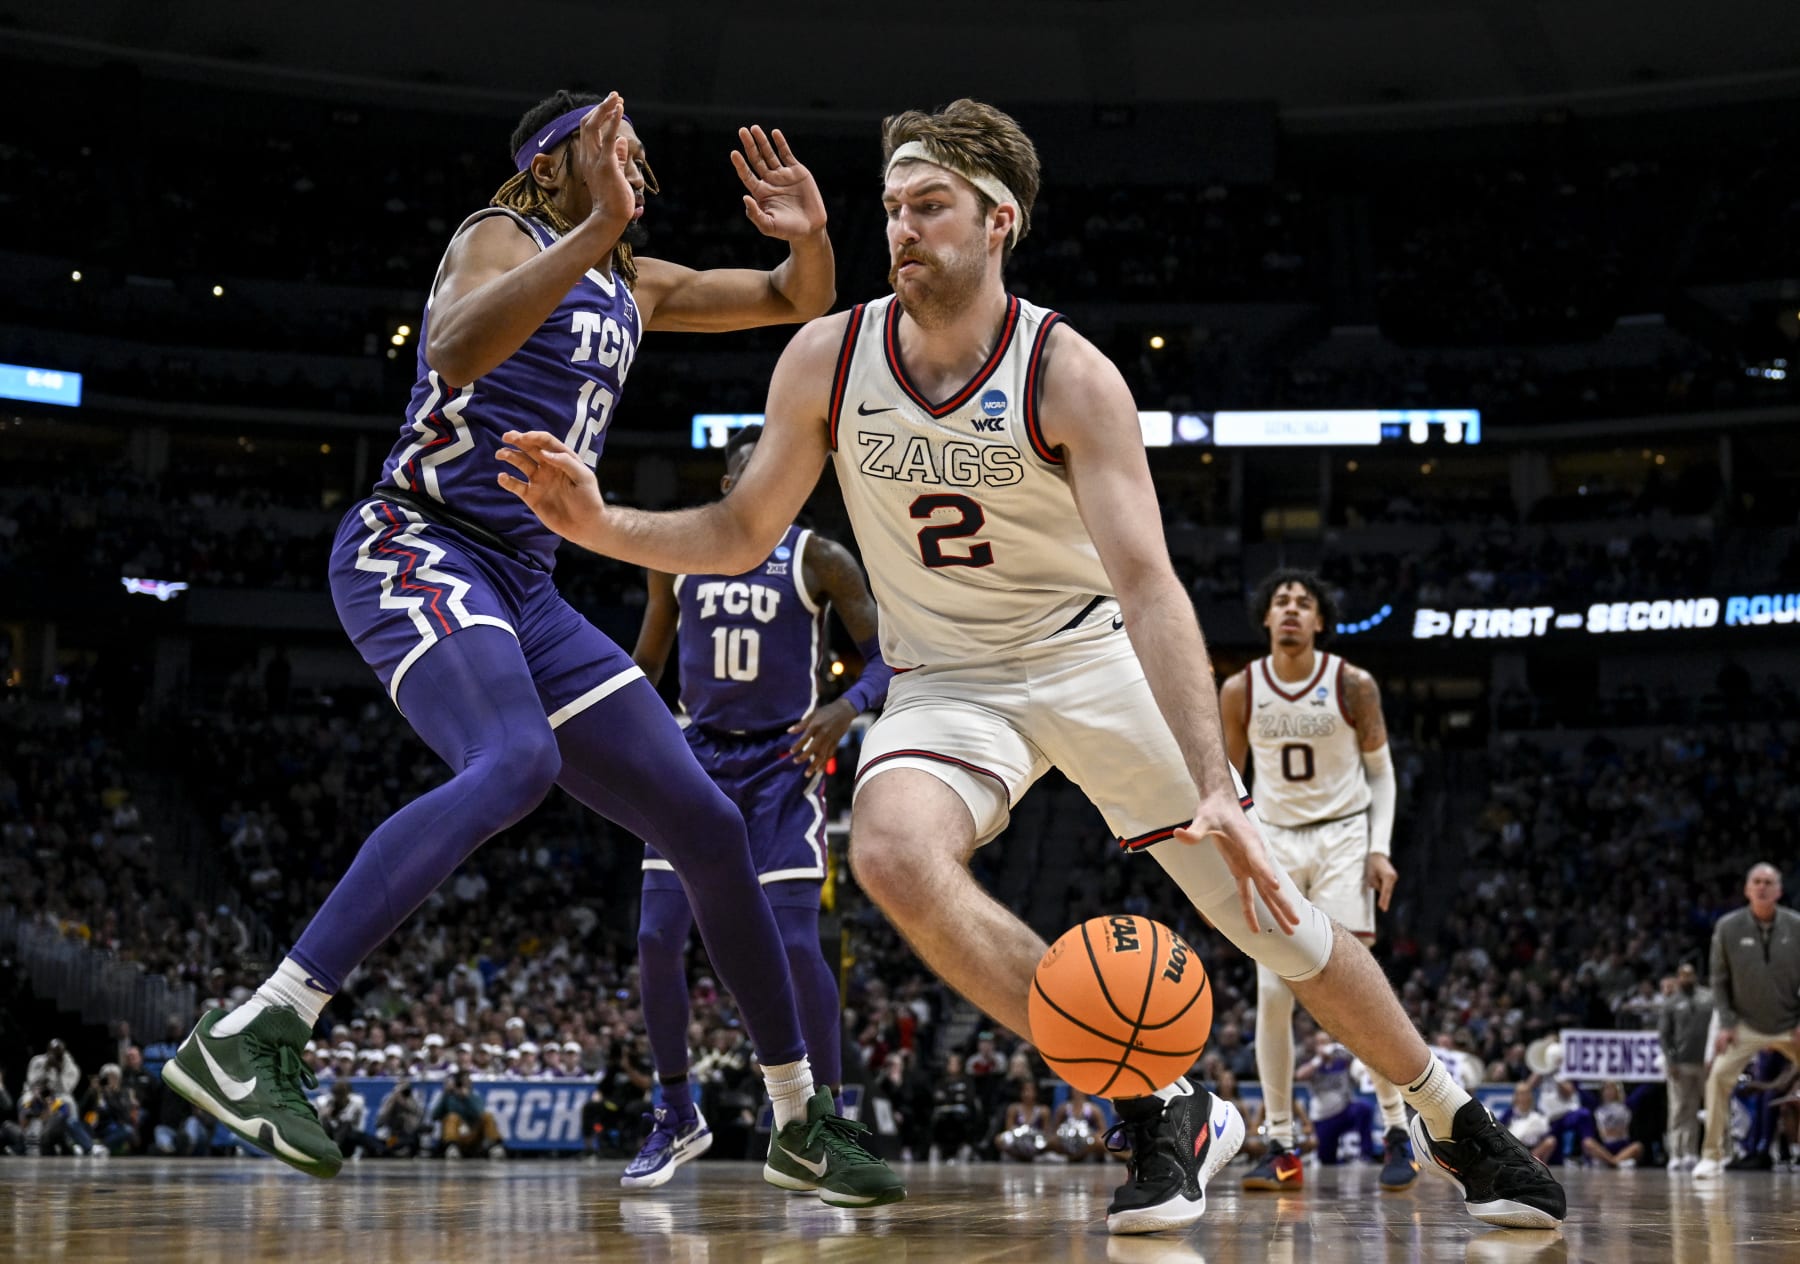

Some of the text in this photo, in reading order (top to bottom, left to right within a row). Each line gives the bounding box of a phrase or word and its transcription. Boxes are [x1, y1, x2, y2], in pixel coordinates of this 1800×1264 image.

[571, 312, 634, 387] TCU
[564, 380, 614, 468] 12
[971, 418, 1005, 432] WCC
[984, 401, 1006, 409] NCAA
[858, 431, 1024, 487] ZAGS
[909, 493, 994, 568] 2
[696, 582, 781, 623] TCU
[1453, 606, 1554, 638] FIRST
[1586, 598, 1719, 633] SECOND
[1725, 593, 1800, 626] ROU
[711, 627, 760, 681] 10
[1258, 713, 1335, 737] ZAGS
[1282, 743, 1315, 782] 0
[1109, 916, 1139, 952] CAA
[1566, 1036, 1660, 1074] DEFENSE
[412, 1088, 589, 1142] RCH
